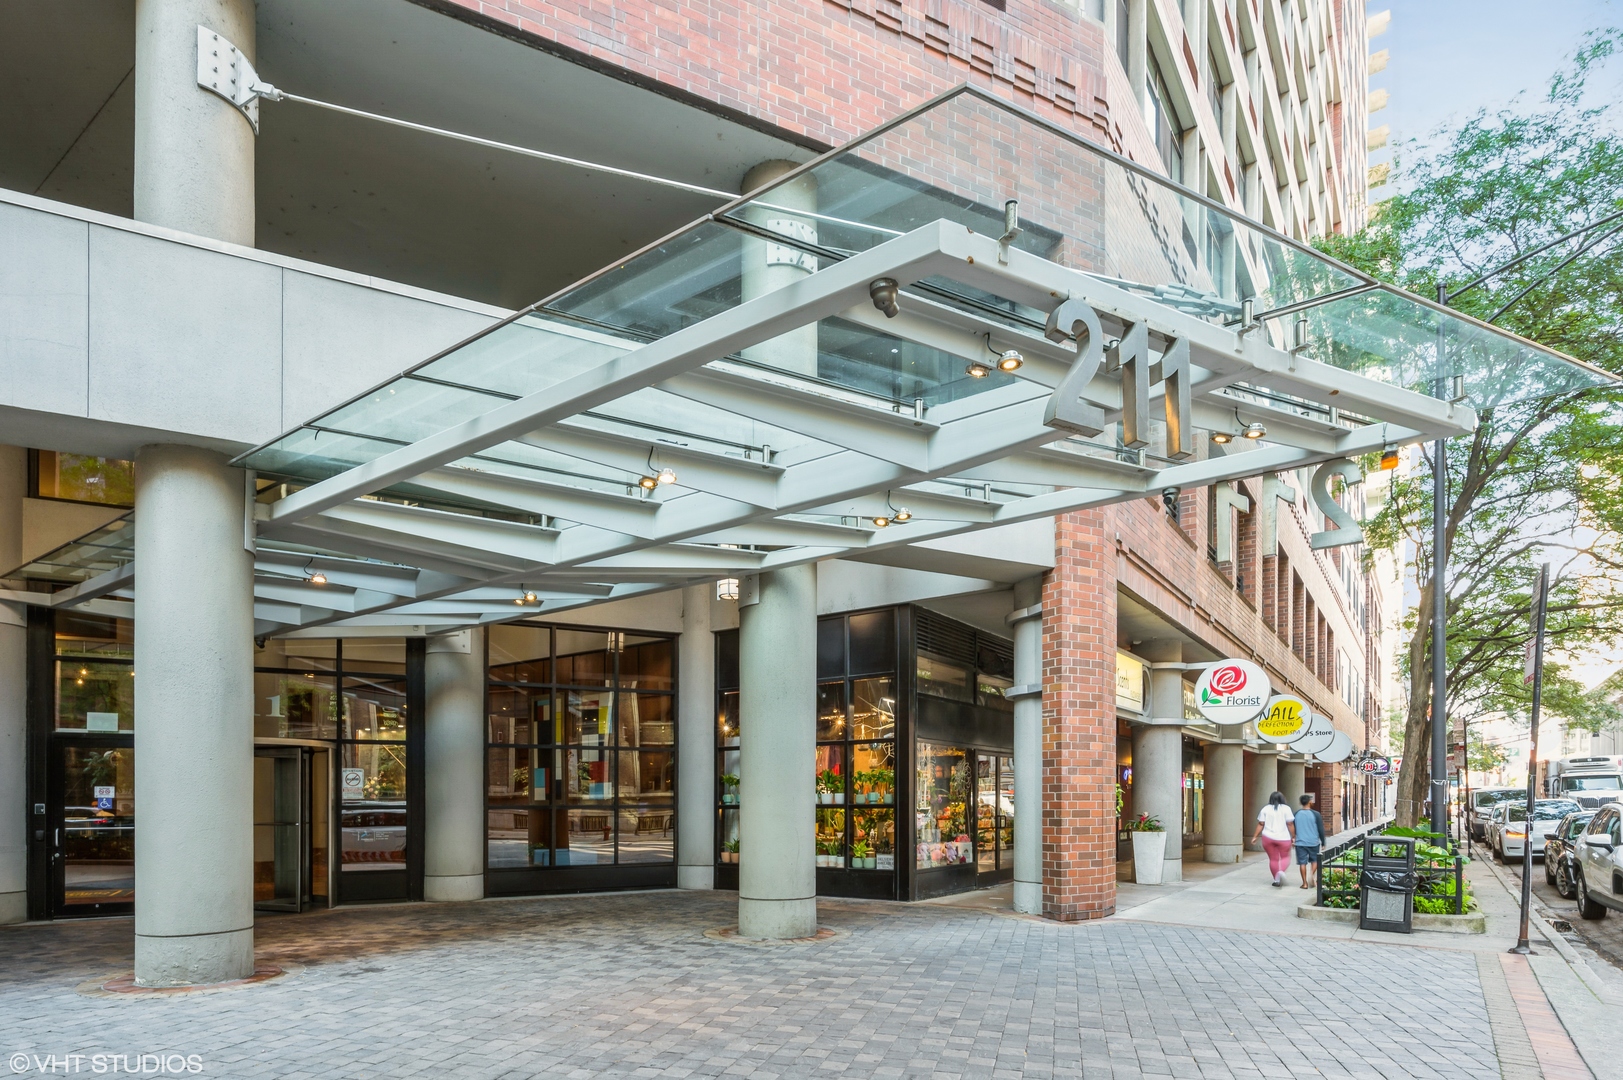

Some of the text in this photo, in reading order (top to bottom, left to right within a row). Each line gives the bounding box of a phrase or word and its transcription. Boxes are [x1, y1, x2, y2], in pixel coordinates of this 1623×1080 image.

[1043, 298, 1193, 460] 211
[1226, 695, 1261, 706] Florist
[1259, 706, 1295, 721] NAIL
